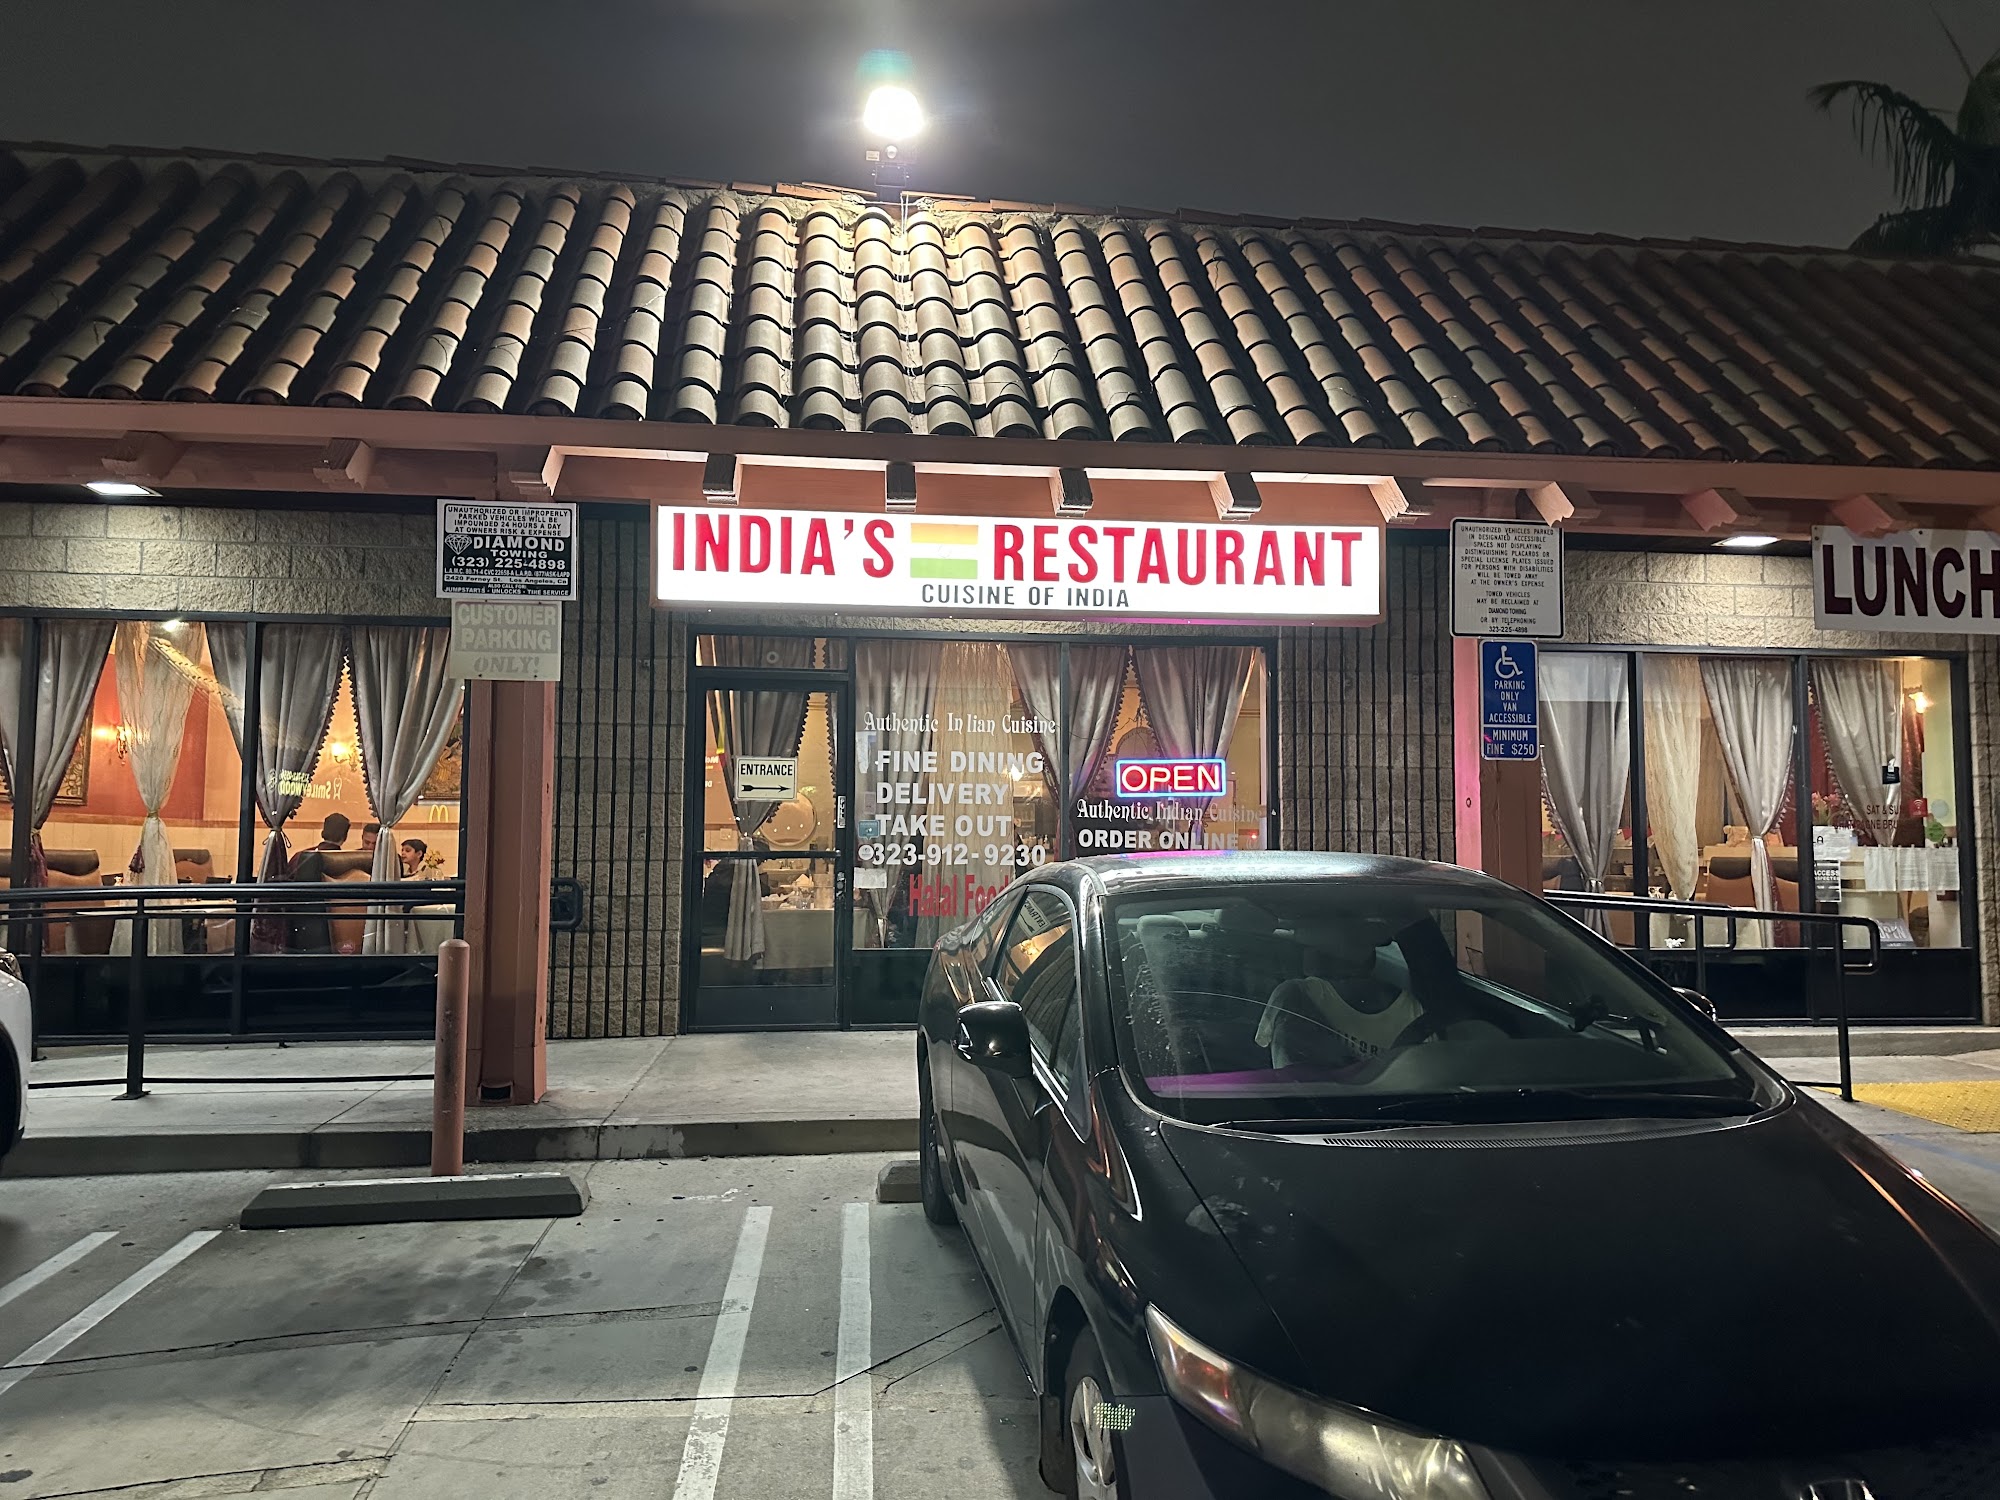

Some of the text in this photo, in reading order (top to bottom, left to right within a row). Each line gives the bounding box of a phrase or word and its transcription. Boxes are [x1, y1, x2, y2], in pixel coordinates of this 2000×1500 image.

[448, 506, 506, 514] UNAUTHORIZED
[490, 514, 526, 522] VEHICLES
[474, 536, 565, 551] DIAMOND
[673, 513, 1362, 586] INDIA'S RESTAURANT
[452, 556, 565, 570] (323) 225-4898
[490, 550, 547, 558] TOWING
[1822, 544, 2000, 619] LUNCH
[922, 584, 1129, 608] CUISINE OF INDIA
[458, 604, 556, 626] CUSTOMER
[461, 628, 551, 650] PARKING
[474, 656, 540, 674] ONLY!
[1494, 680, 1526, 690] PARKING
[1500, 691, 1519, 700] ONLY
[1503, 702, 1517, 712] VAN
[864, 712, 938, 734] Authentic
[1002, 715, 1056, 736] Cuisine
[1489, 714, 1532, 723] ACCESSIBLE
[1493, 730, 1528, 741] MINIMUM
[1487, 743, 1534, 755] FINE $250
[740, 764, 793, 776] ENTRANCE
[877, 751, 1044, 773] FINE DINING
[1121, 765, 1220, 792] OPEN
[876, 783, 1009, 805] DELIVERY
[1077, 798, 1262, 825] Authentic Indian Cuisine
[1867, 805, 1899, 815] SAT & SU
[875, 814, 1012, 836] TAKE OUT
[1078, 829, 1151, 849] ORDER
[1159, 831, 1239, 850] ONLINE
[909, 874, 957, 917] Halal
